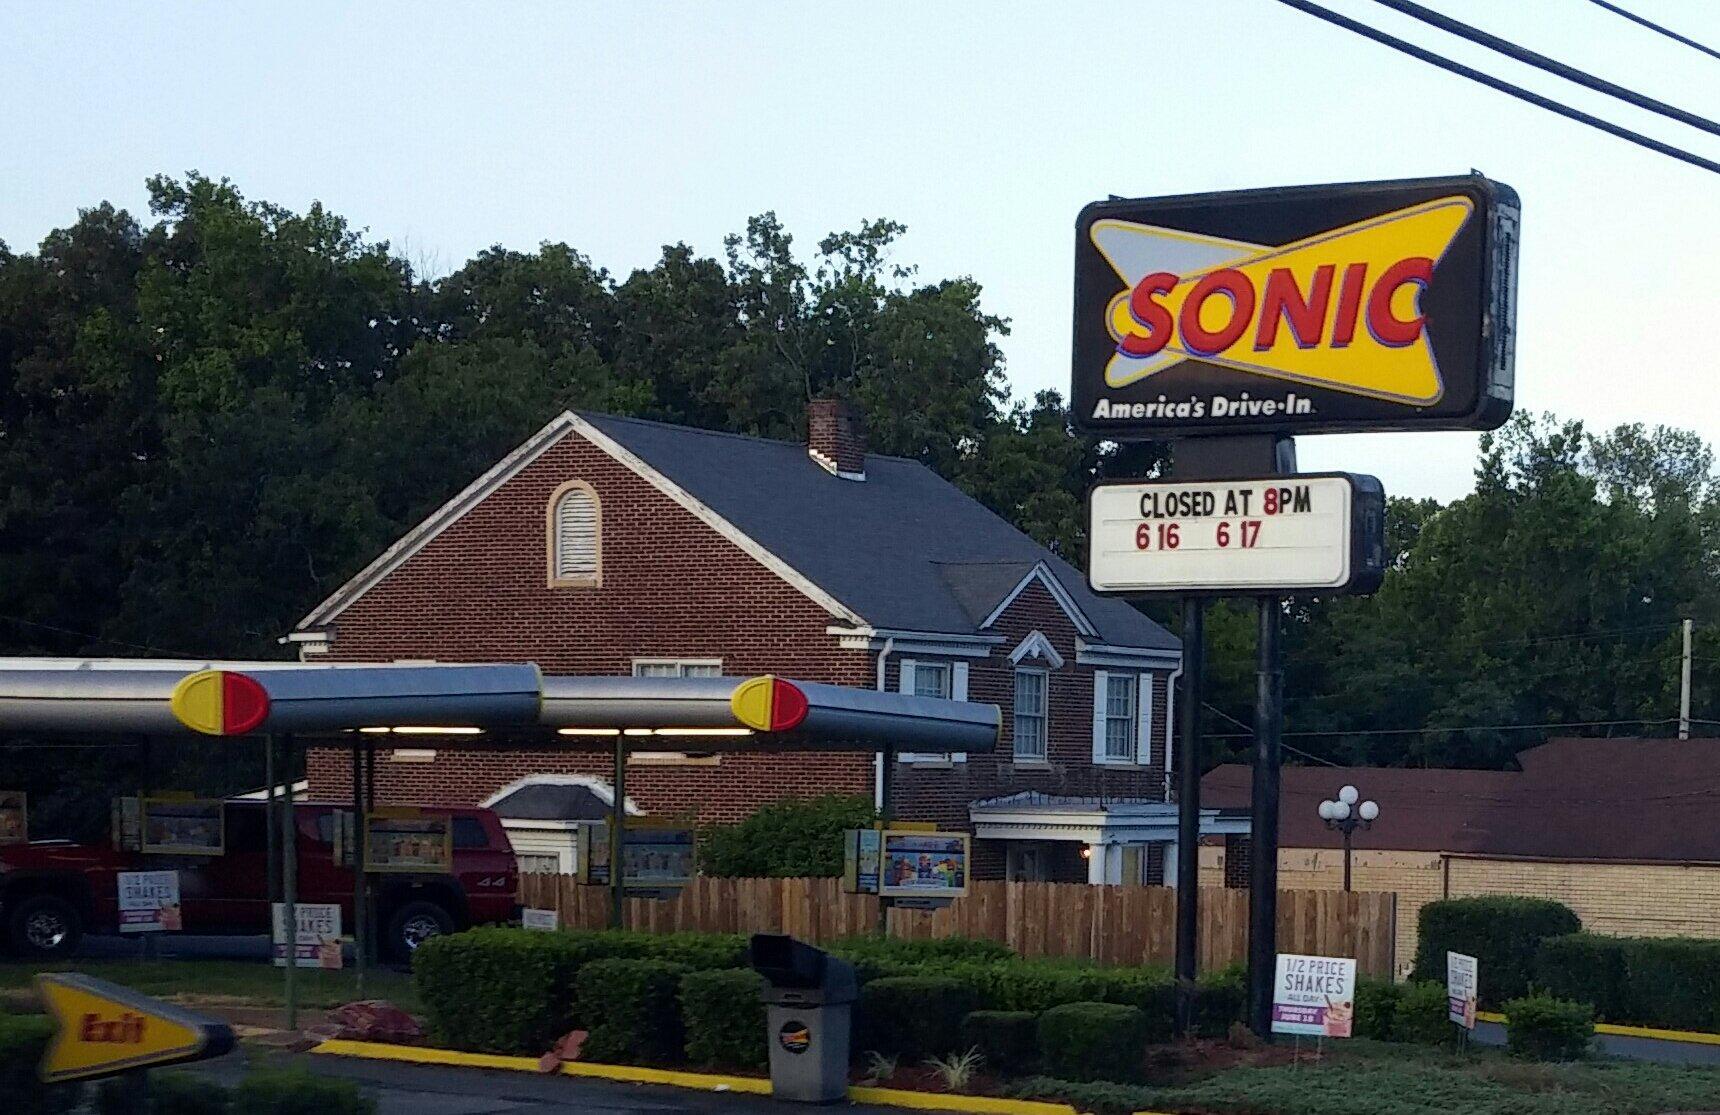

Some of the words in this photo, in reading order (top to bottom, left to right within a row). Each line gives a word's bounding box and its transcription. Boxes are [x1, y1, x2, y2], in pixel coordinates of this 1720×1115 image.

[1117, 257, 1433, 358] SONIC
[1092, 394, 1206, 419] America's
[1140, 491, 1216, 518] CLOSED
[1224, 489, 1253, 516] AT
[1263, 485, 1312, 516] 8PM
[1136, 523, 1150, 550] 6
[1158, 523, 1180, 551] 16
[1216, 521, 1230, 547] 6
[1241, 520, 1262, 548] 17
[1286, 958, 1305, 973] 1/2
[1308, 959, 1346, 976] PRICE
[1284, 973, 1345, 995] SHAKES
[80, 1012, 146, 1043] Exit
